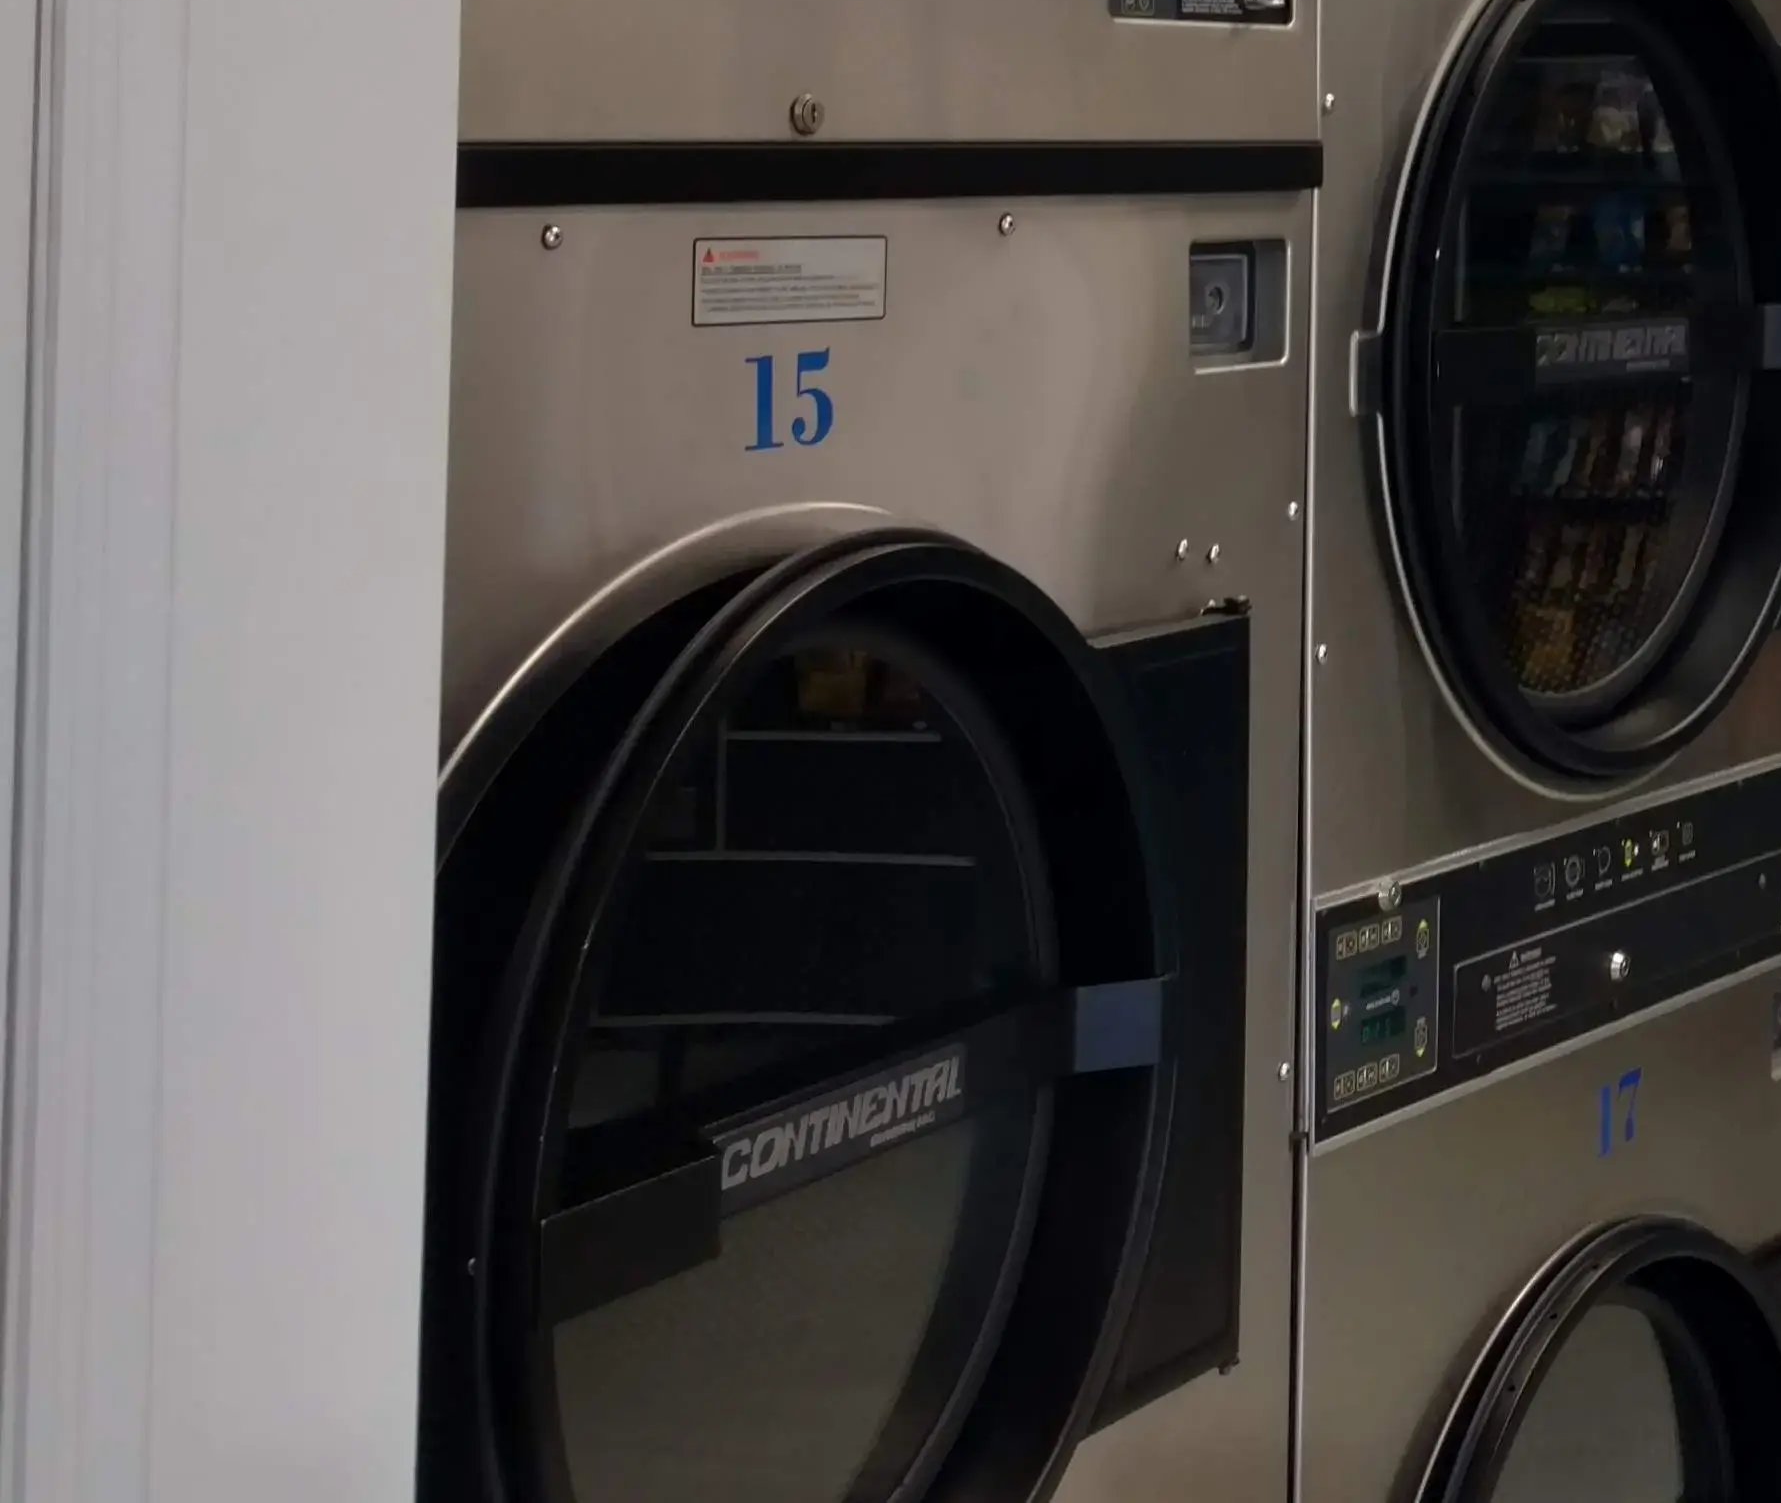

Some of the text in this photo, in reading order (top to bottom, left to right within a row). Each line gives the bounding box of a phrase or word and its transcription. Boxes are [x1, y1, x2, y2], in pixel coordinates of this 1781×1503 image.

[743, 346, 835, 452] 15
[721, 1055, 963, 1190] CONTINENTAL
[1600, 1066, 1643, 1158] 17
